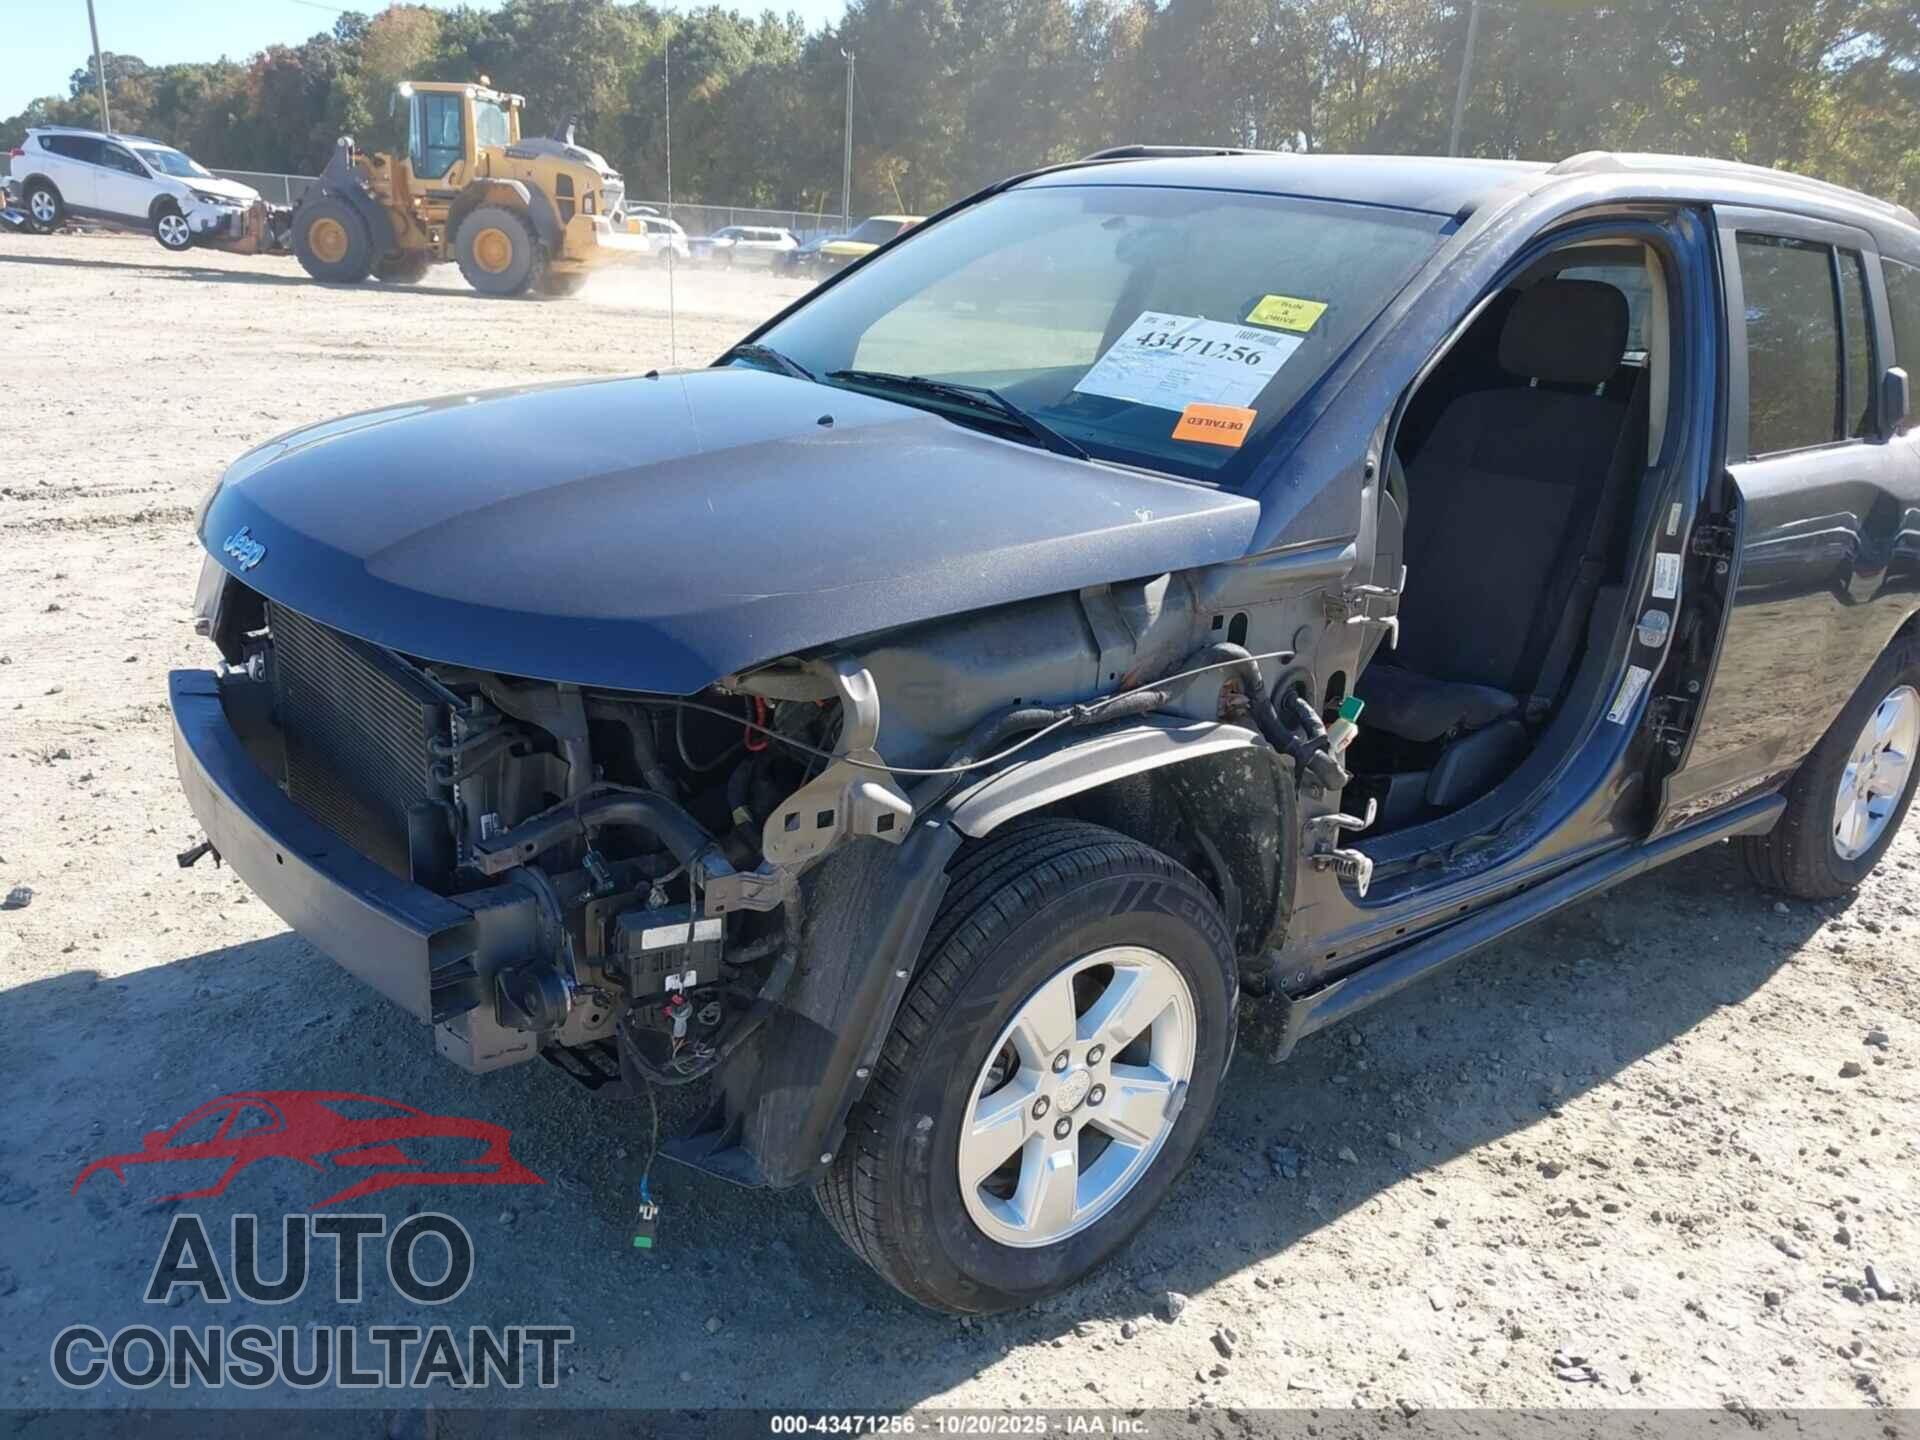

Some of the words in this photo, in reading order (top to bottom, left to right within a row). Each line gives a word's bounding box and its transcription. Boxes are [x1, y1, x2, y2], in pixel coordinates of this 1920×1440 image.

[1136, 331, 1264, 366] 43471256
[1187, 416, 1244, 431] DETAILED
[223, 526, 266, 572] Jeep
